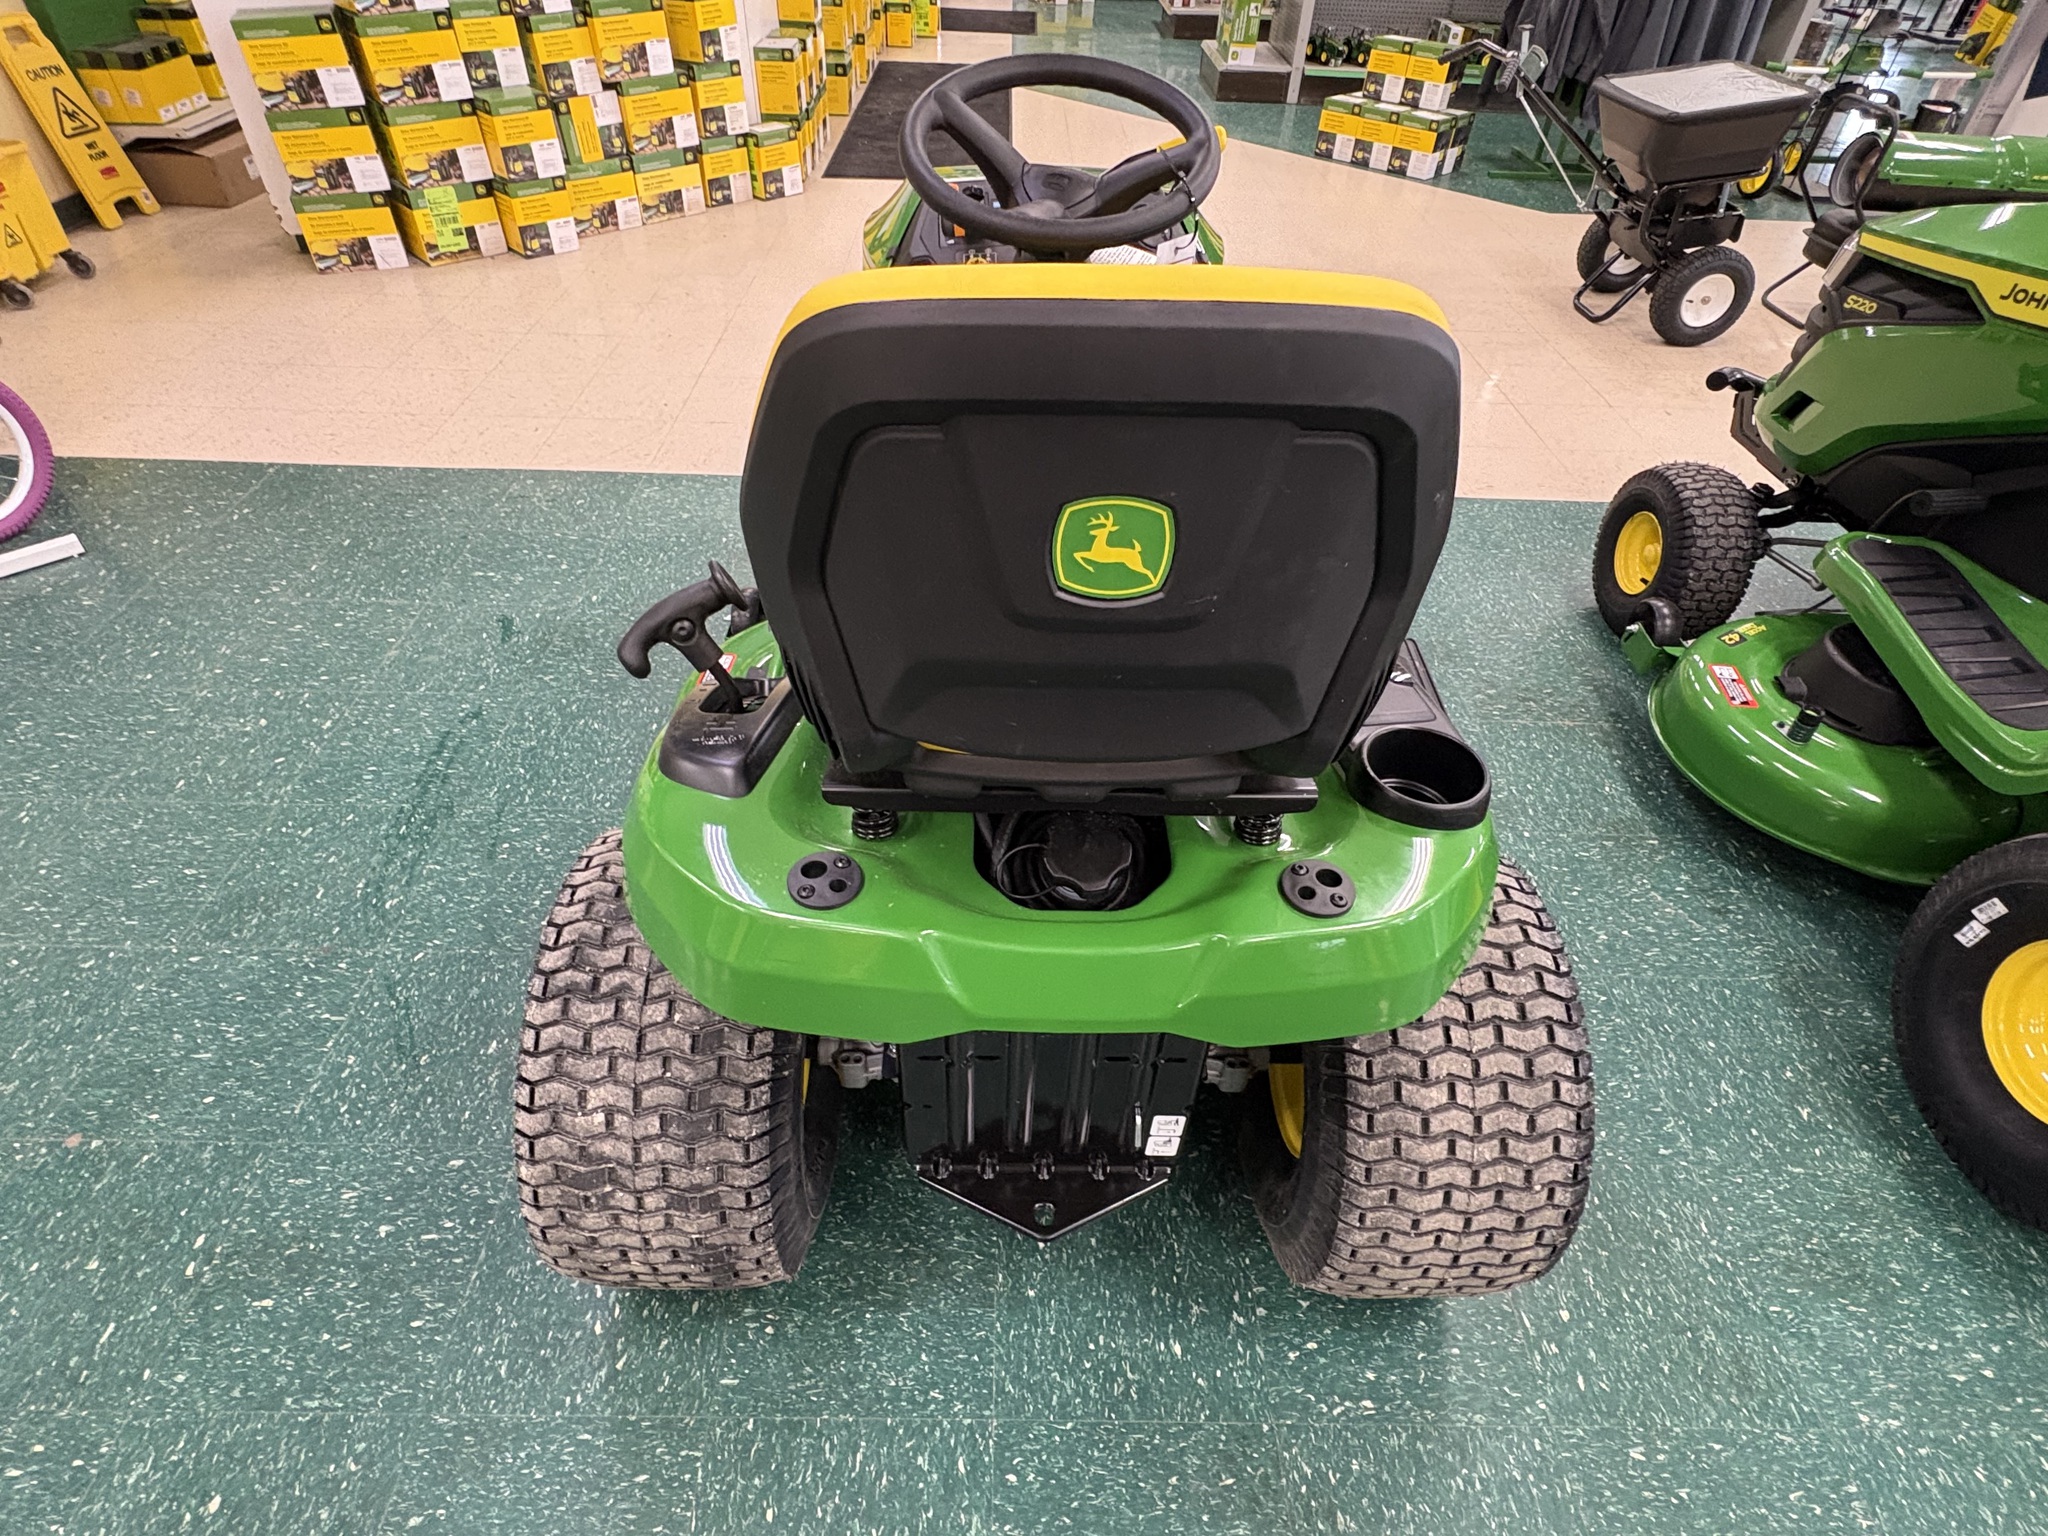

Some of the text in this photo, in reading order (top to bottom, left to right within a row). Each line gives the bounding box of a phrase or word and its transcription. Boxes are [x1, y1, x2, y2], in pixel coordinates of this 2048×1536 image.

[25, 63, 65, 81] CAUTION
[84, 141, 98, 150] WET
[87, 150, 109, 161] FLOOR
[1843, 295, 1877, 314] S220
[1721, 633, 1740, 644] 42
